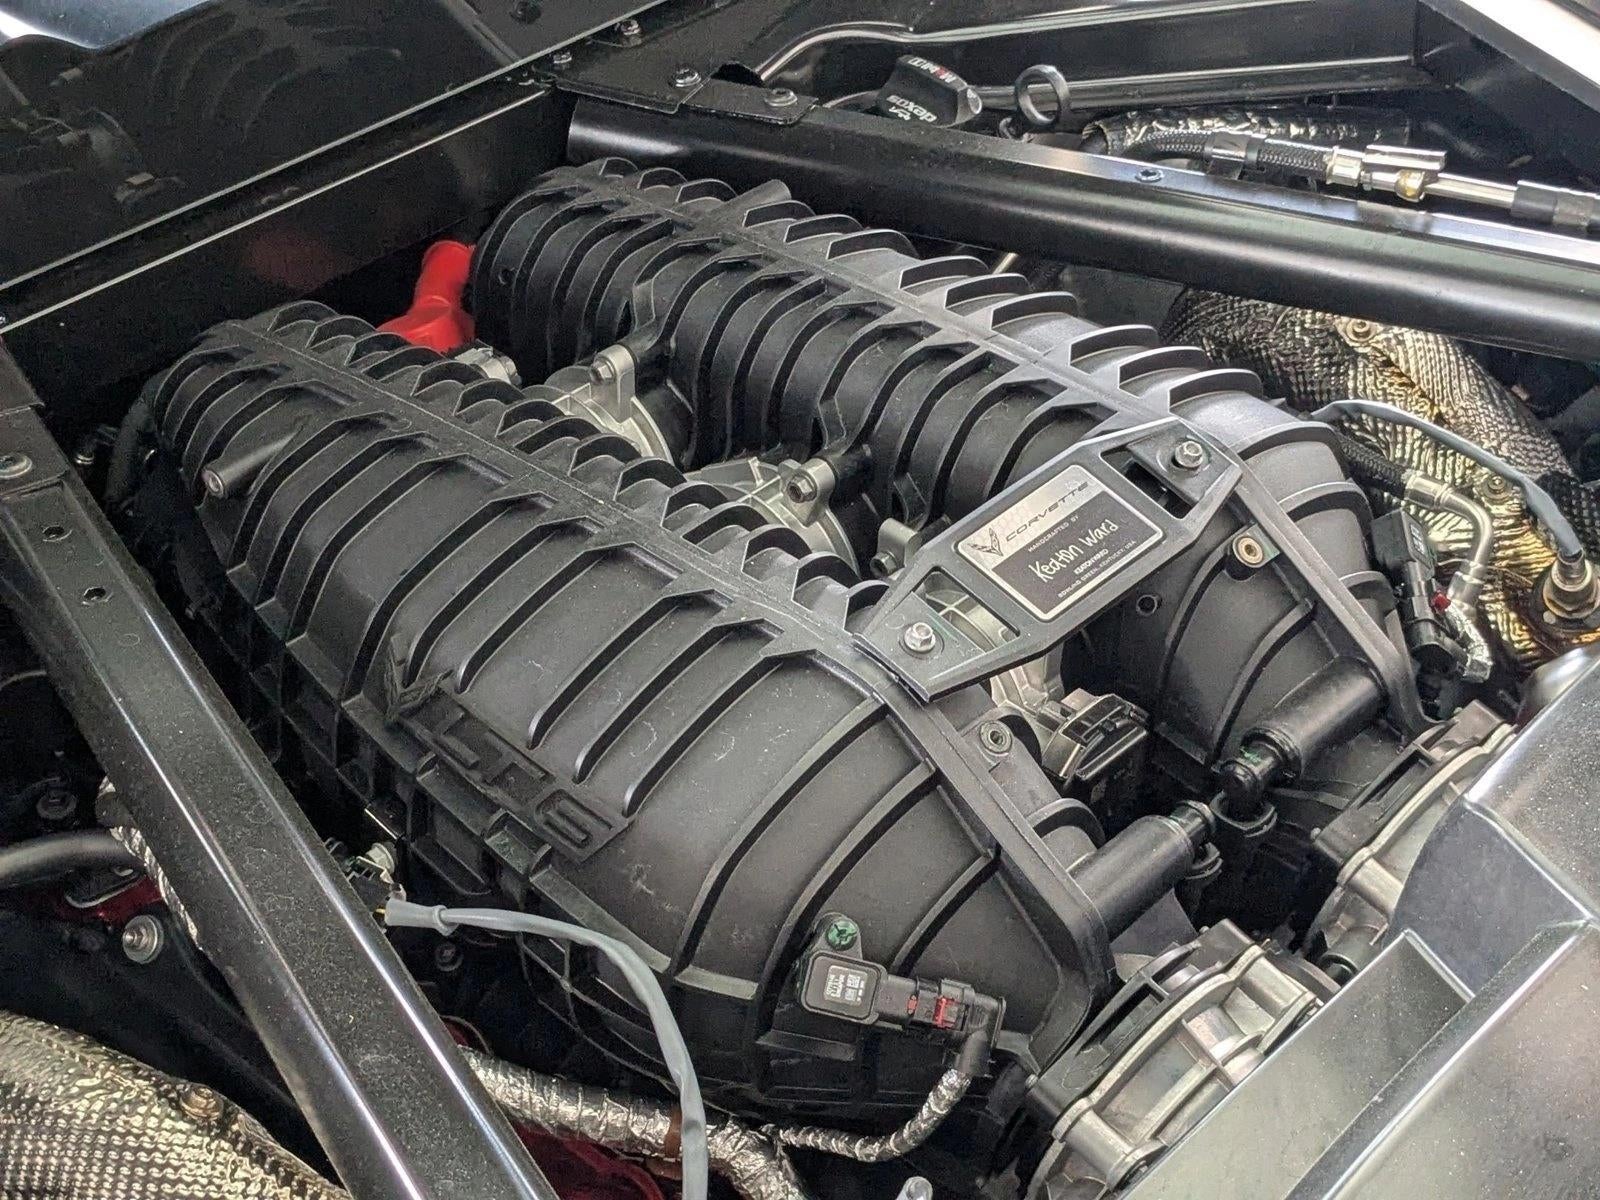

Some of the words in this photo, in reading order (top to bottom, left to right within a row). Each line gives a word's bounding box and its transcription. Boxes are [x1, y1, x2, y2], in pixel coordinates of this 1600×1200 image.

[886, 94, 937, 122] dexos
[1006, 482, 1089, 541] CORVETTE
[1028, 523, 1070, 552] HANDCRAFTED
[1028, 544, 1085, 583] Keaton
[1078, 518, 1119, 549] Ward
